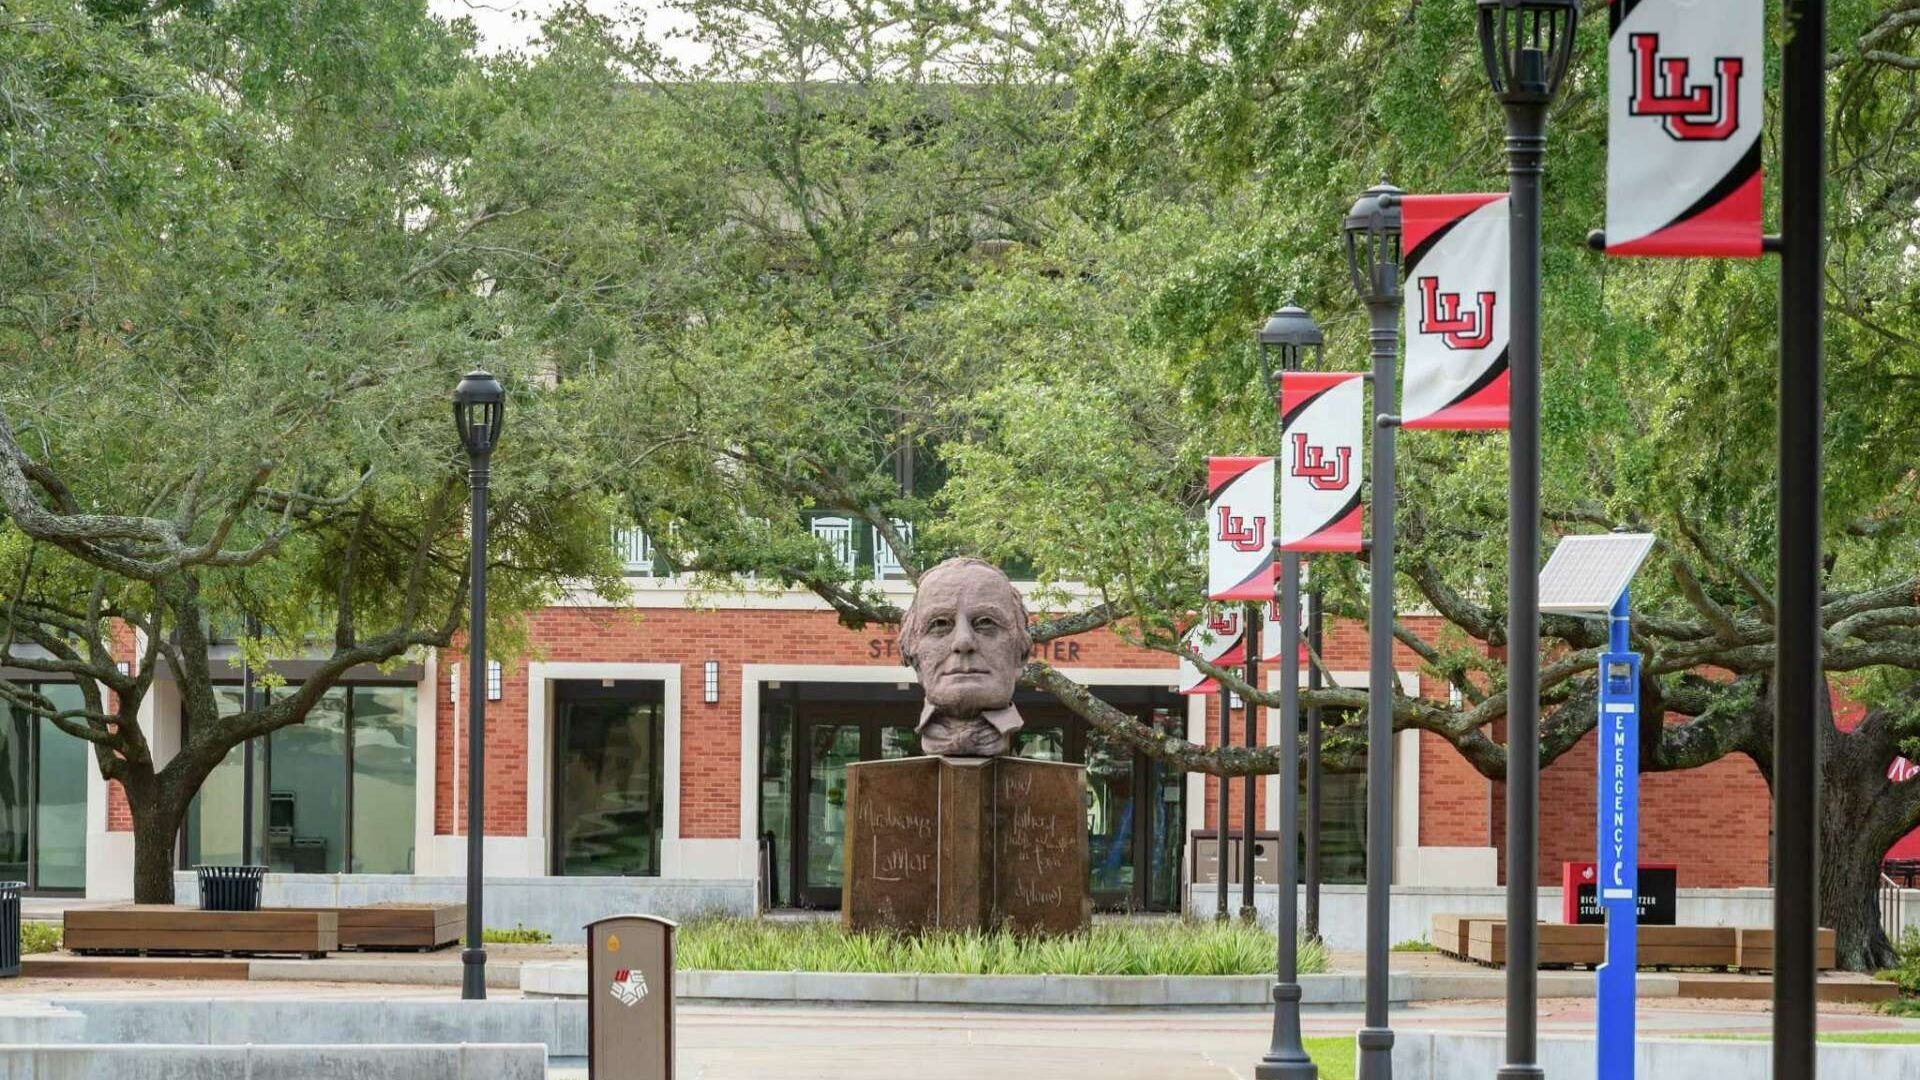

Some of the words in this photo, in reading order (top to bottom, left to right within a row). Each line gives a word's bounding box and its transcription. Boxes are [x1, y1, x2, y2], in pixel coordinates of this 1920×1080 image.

[1629, 32, 1744, 141] LU
[1418, 276, 1496, 350] LU
[1292, 433, 1351, 490] LU
[1218, 506, 1266, 552] LU
[1614, 715, 1625, 858] EMERGENCY
[1580, 896, 1598, 904] RICH
[1638, 896, 1656, 905] TZER
[1580, 906, 1605, 915] STUDE
